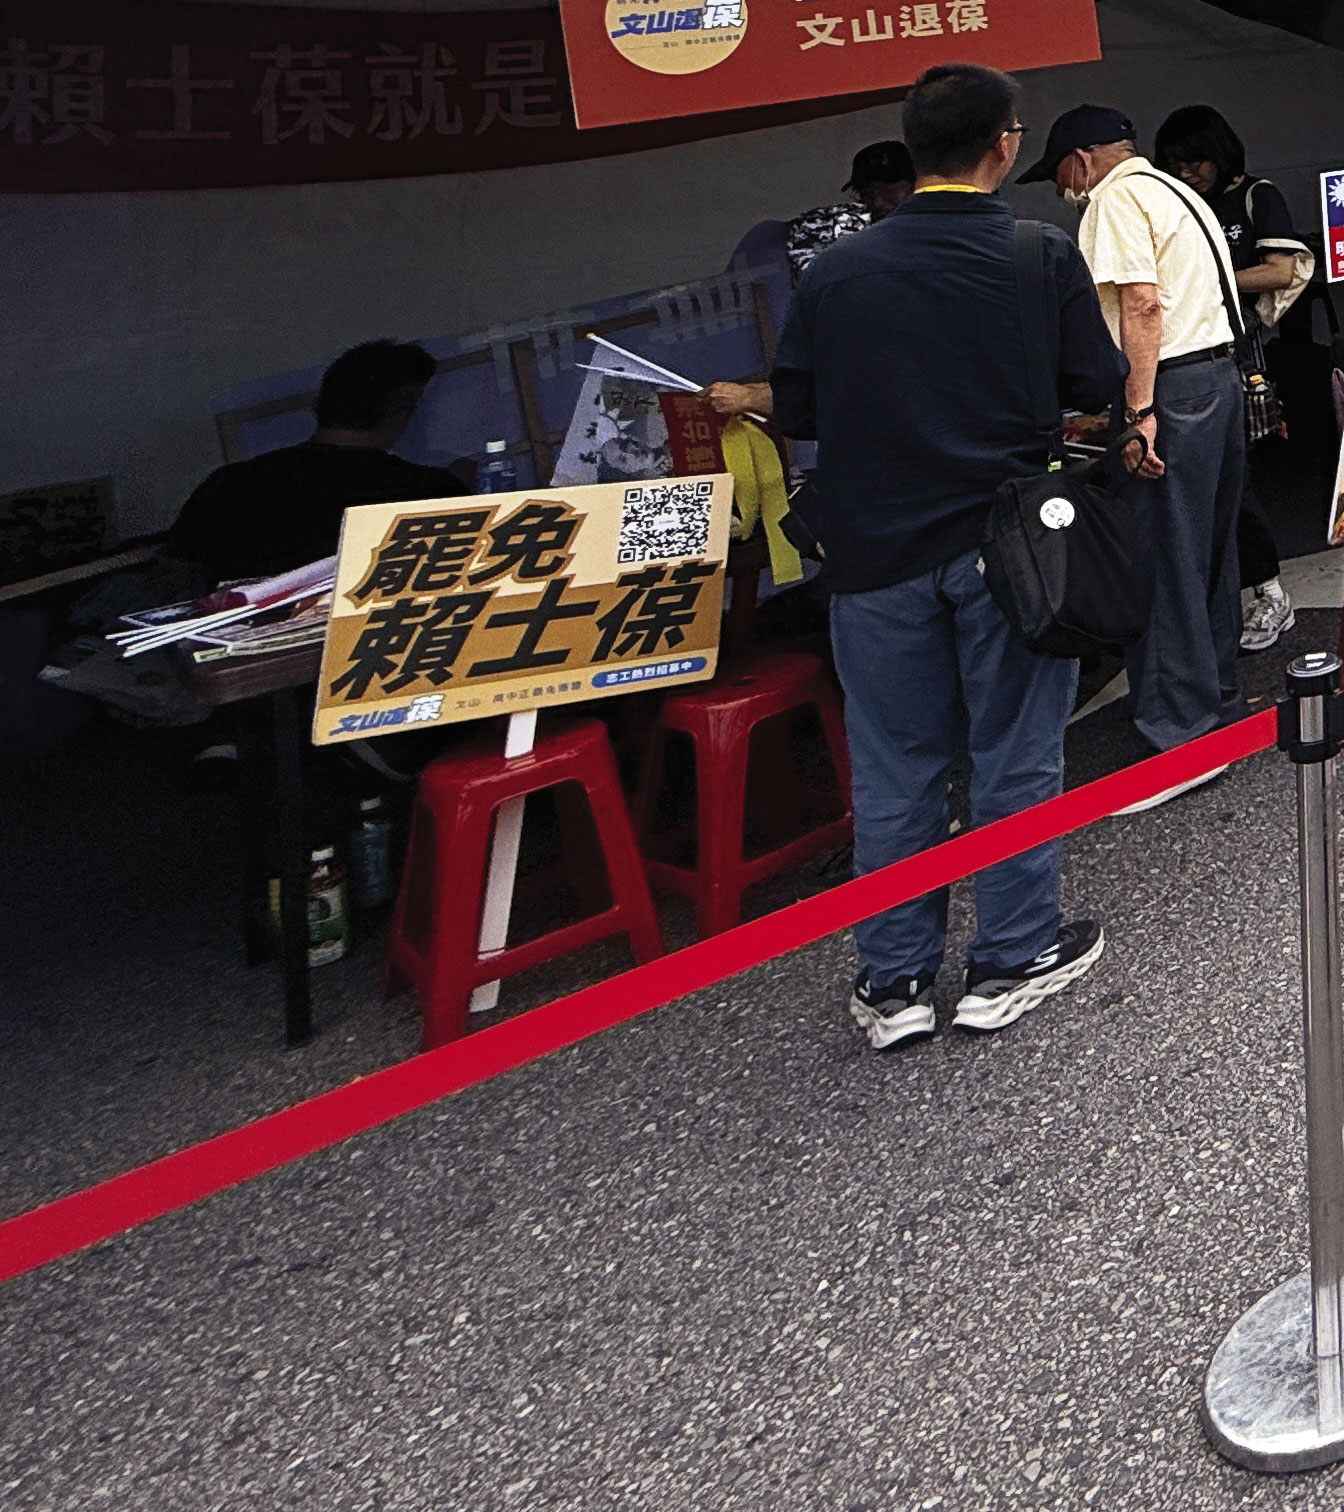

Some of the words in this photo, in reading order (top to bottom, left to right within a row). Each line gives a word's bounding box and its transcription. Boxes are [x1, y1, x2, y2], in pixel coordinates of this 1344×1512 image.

[796, 0, 989, 51] 文山退葆
[350, 500, 582, 602] 罷免
[329, 562, 725, 701] 賴士葆
